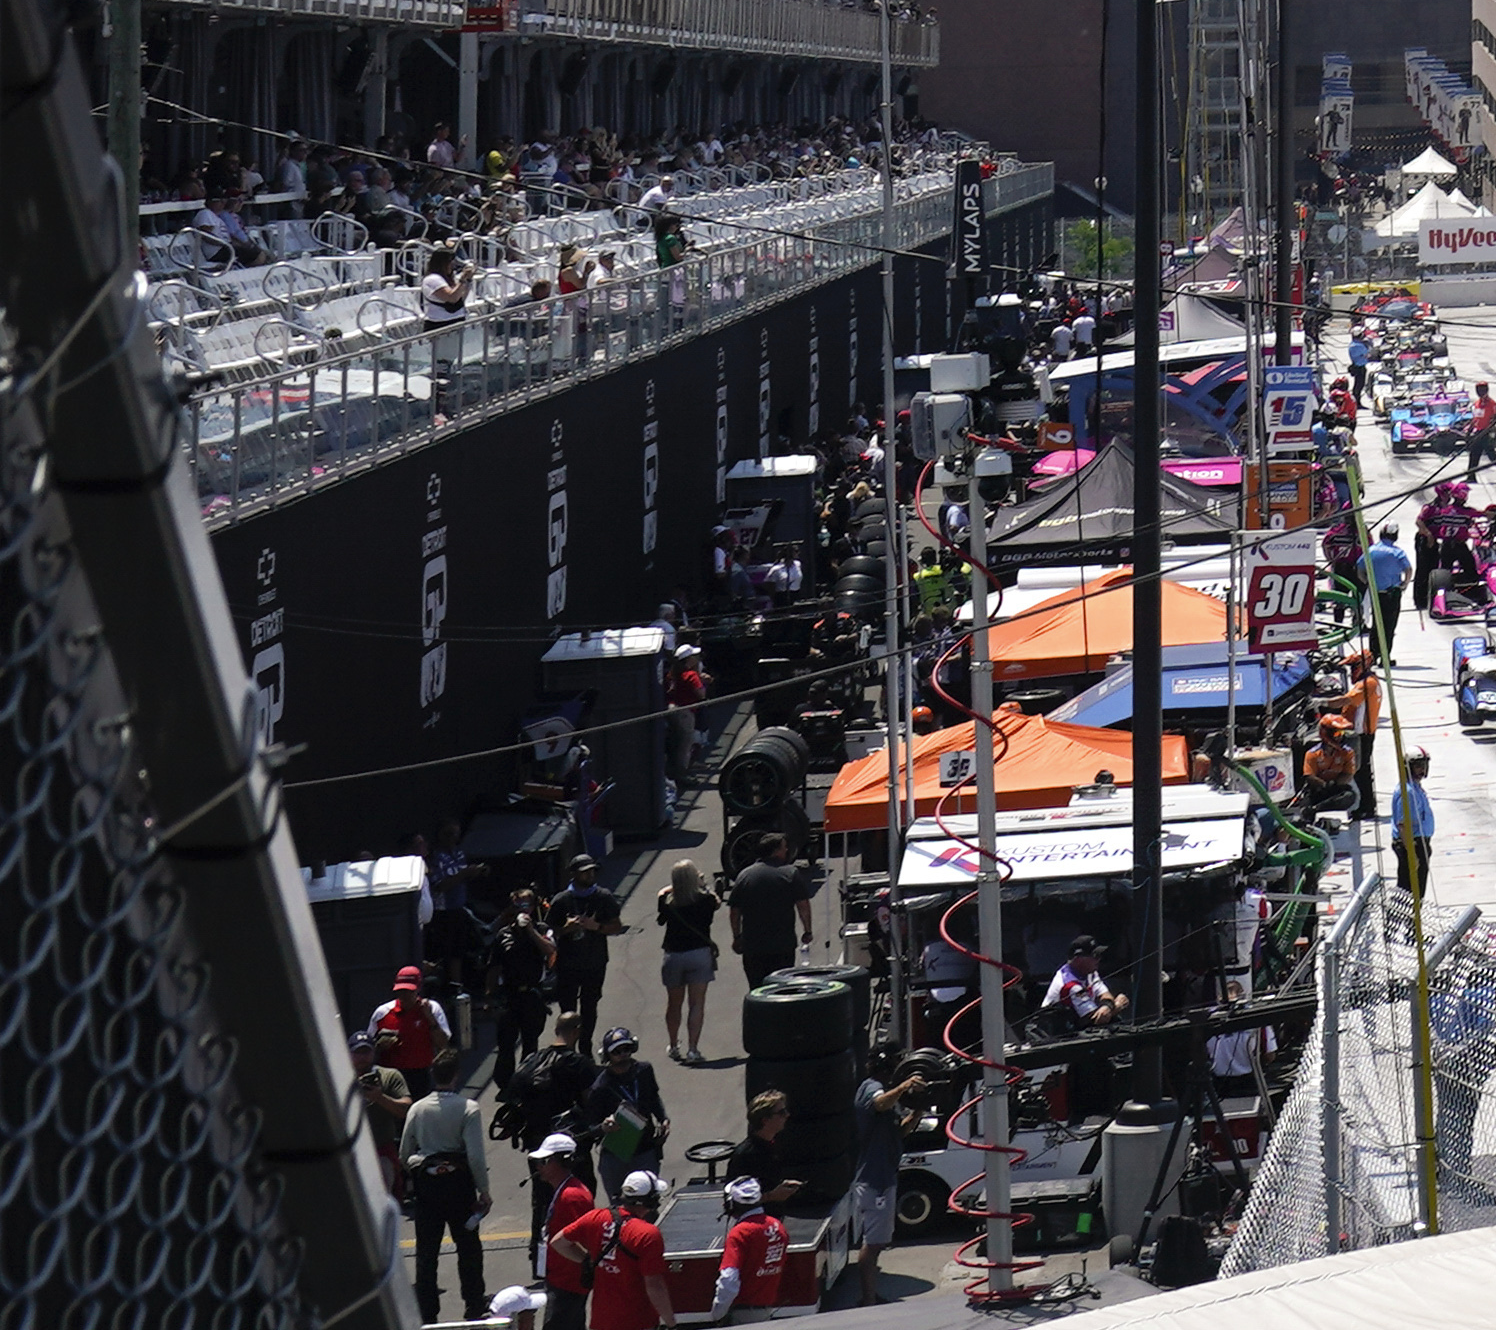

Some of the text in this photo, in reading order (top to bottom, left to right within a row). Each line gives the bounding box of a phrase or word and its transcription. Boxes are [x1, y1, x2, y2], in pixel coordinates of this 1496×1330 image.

[964, 182, 981, 274] MYLAPS
[1269, 396, 1307, 427] 15
[1173, 470, 1224, 479] ation
[1253, 573, 1310, 618] 30
[251, 607, 285, 648] DETROIT
[1255, 765, 1278, 791] VP
[995, 840, 1106, 857] KUSTOM
[997, 839, 1218, 866] NTERTAINENT
